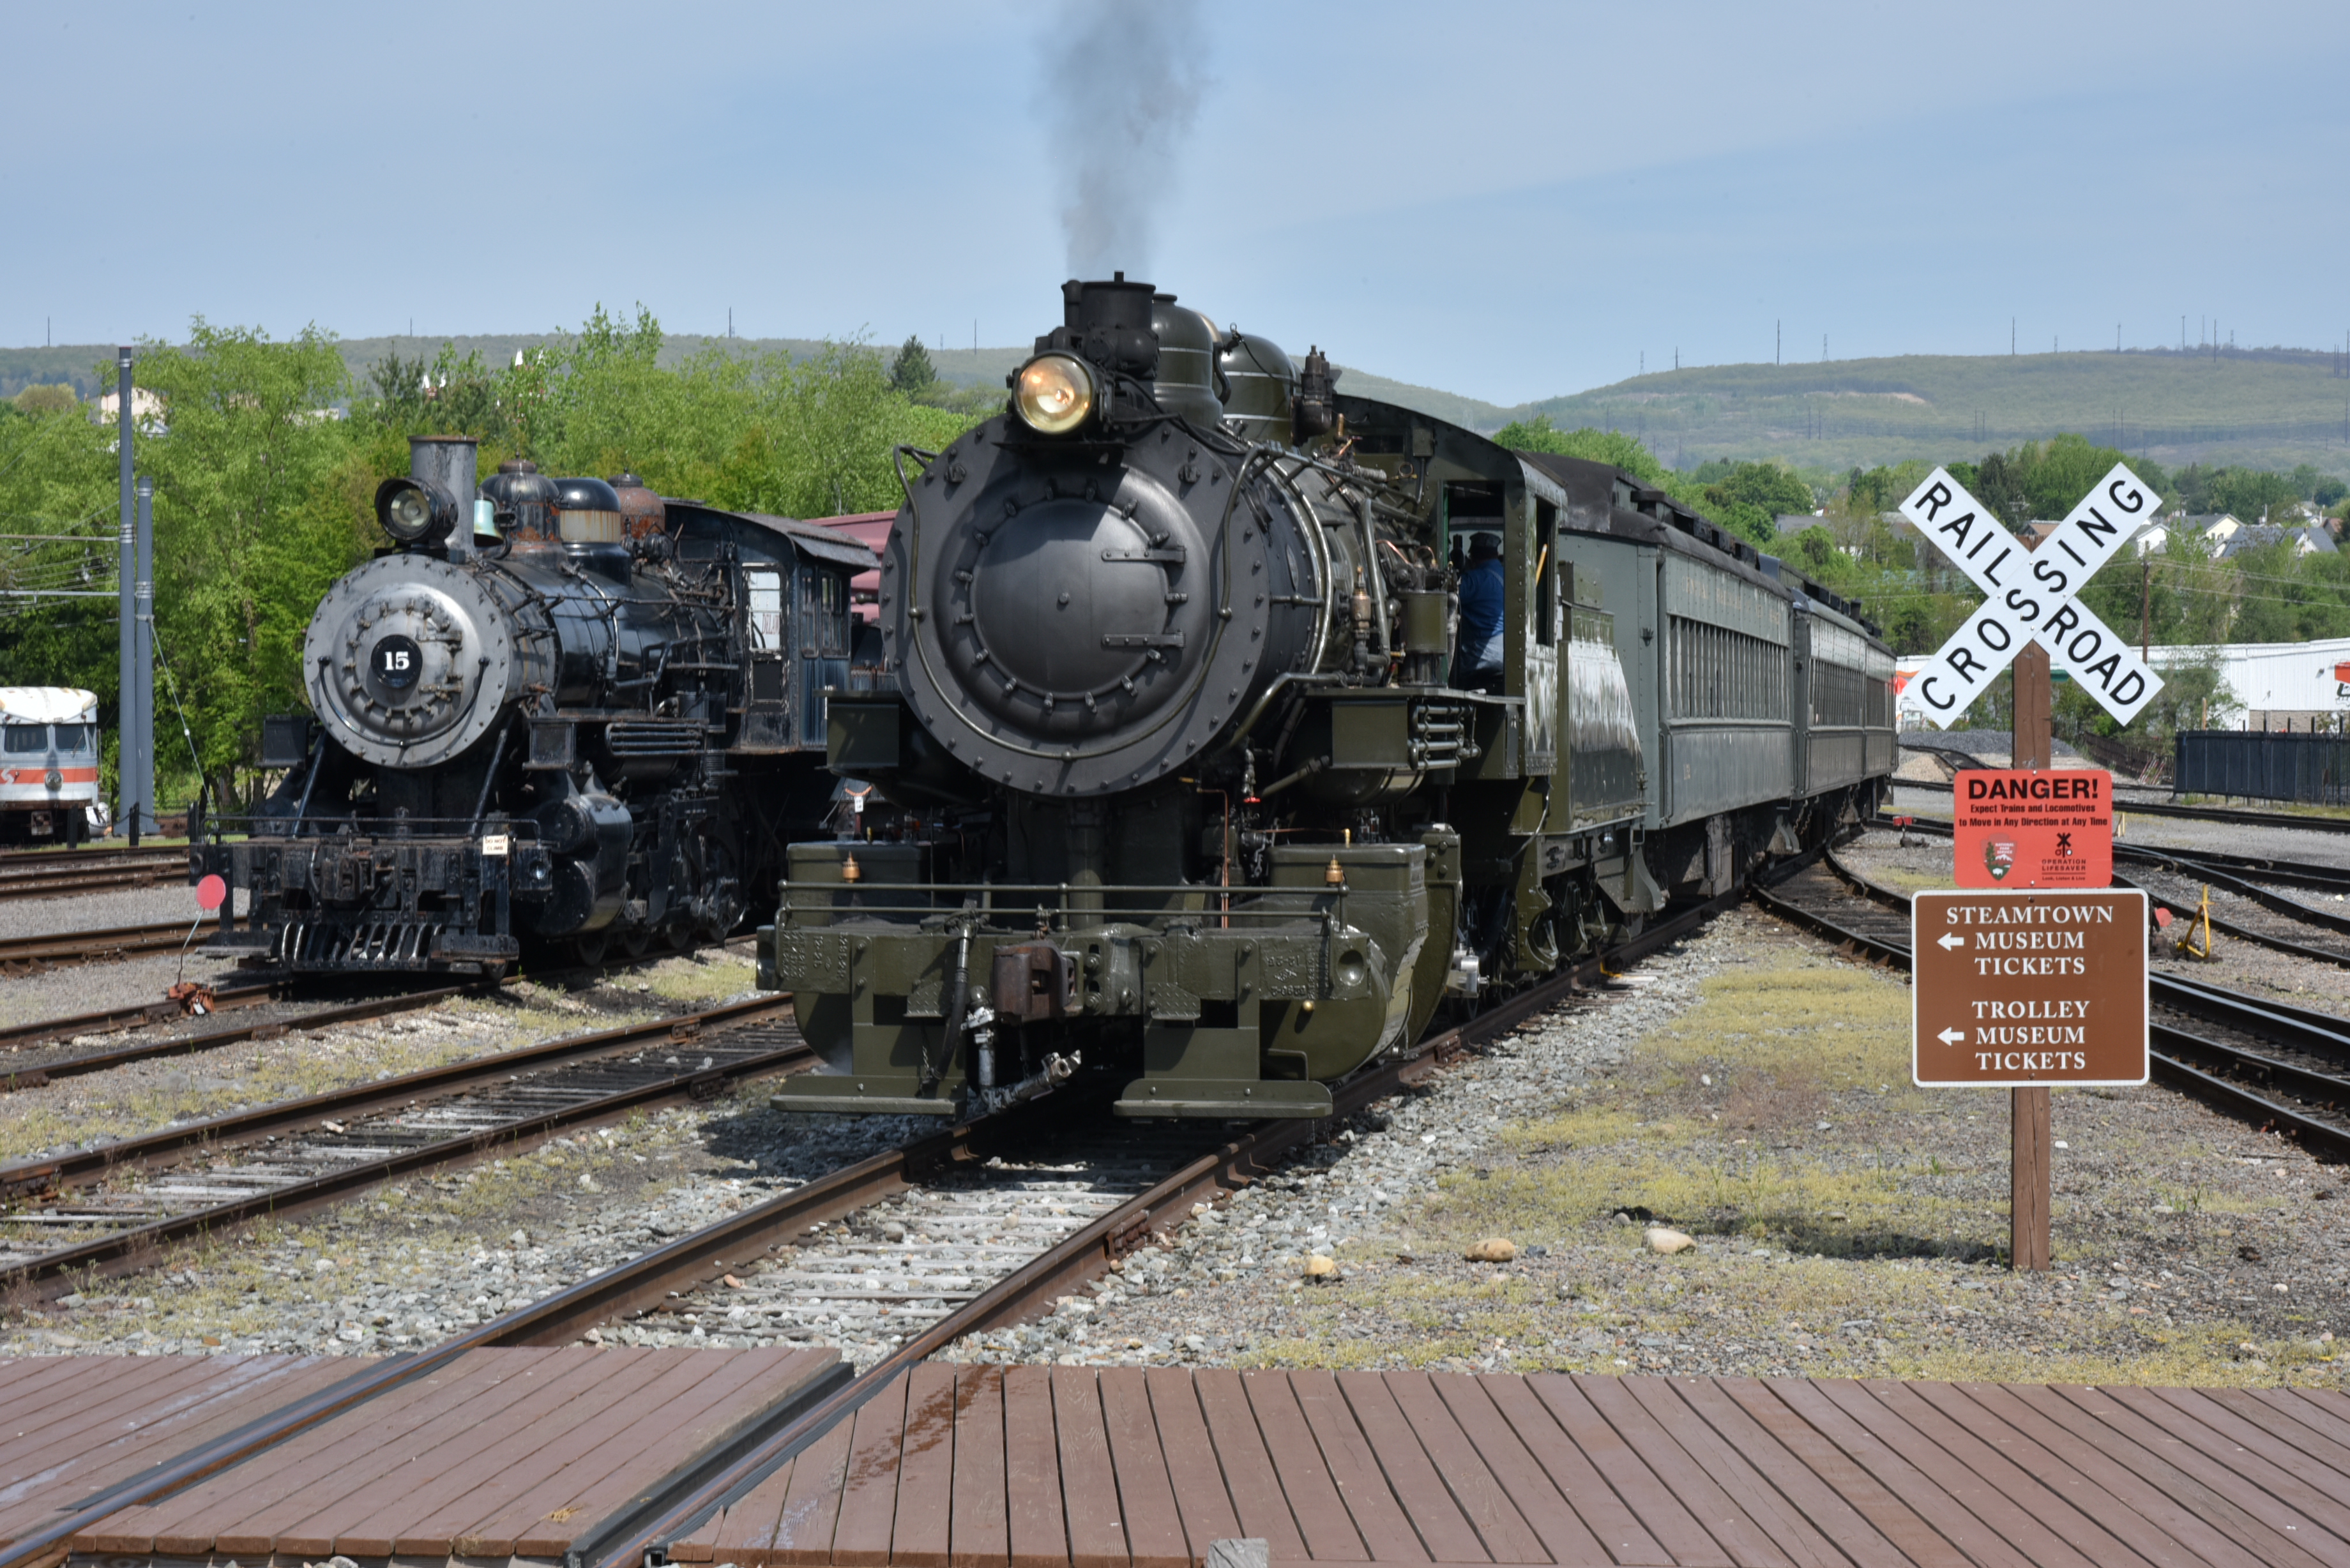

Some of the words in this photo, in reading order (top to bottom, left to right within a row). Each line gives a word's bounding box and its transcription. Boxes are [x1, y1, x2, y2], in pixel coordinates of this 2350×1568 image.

[1914, 481, 2012, 587] RAIL
[2042, 604, 2145, 705] ROAD
[1921, 479, 2144, 711] CROSSING
[384, 651, 410, 670] 15
[1968, 778, 2098, 799] DANGER!
[1971, 804, 1998, 814] Expect
[2001, 804, 2025, 812] Trains
[2028, 804, 2042, 812] and
[2045, 804, 2095, 812] Locomotives
[1959, 818, 1967, 827] to
[1969, 818, 1991, 827] Move
[1994, 818, 2001, 826] in
[2004, 818, 2018, 827] Any
[2021, 817, 2059, 826] Direction
[2061, 818, 2070, 826] at
[2072, 817, 2086, 827] Any
[2089, 817, 2107, 825] Time
[1946, 905, 2113, 924] STEAMTOWN
[1975, 931, 2084, 949] MUSEUM
[1975, 957, 2085, 975] TICKETS
[1972, 1000, 2090, 1019] TROLLEY
[1975, 1027, 2085, 1044] MUSEUM
[1975, 1052, 2086, 1070] TICKETS
